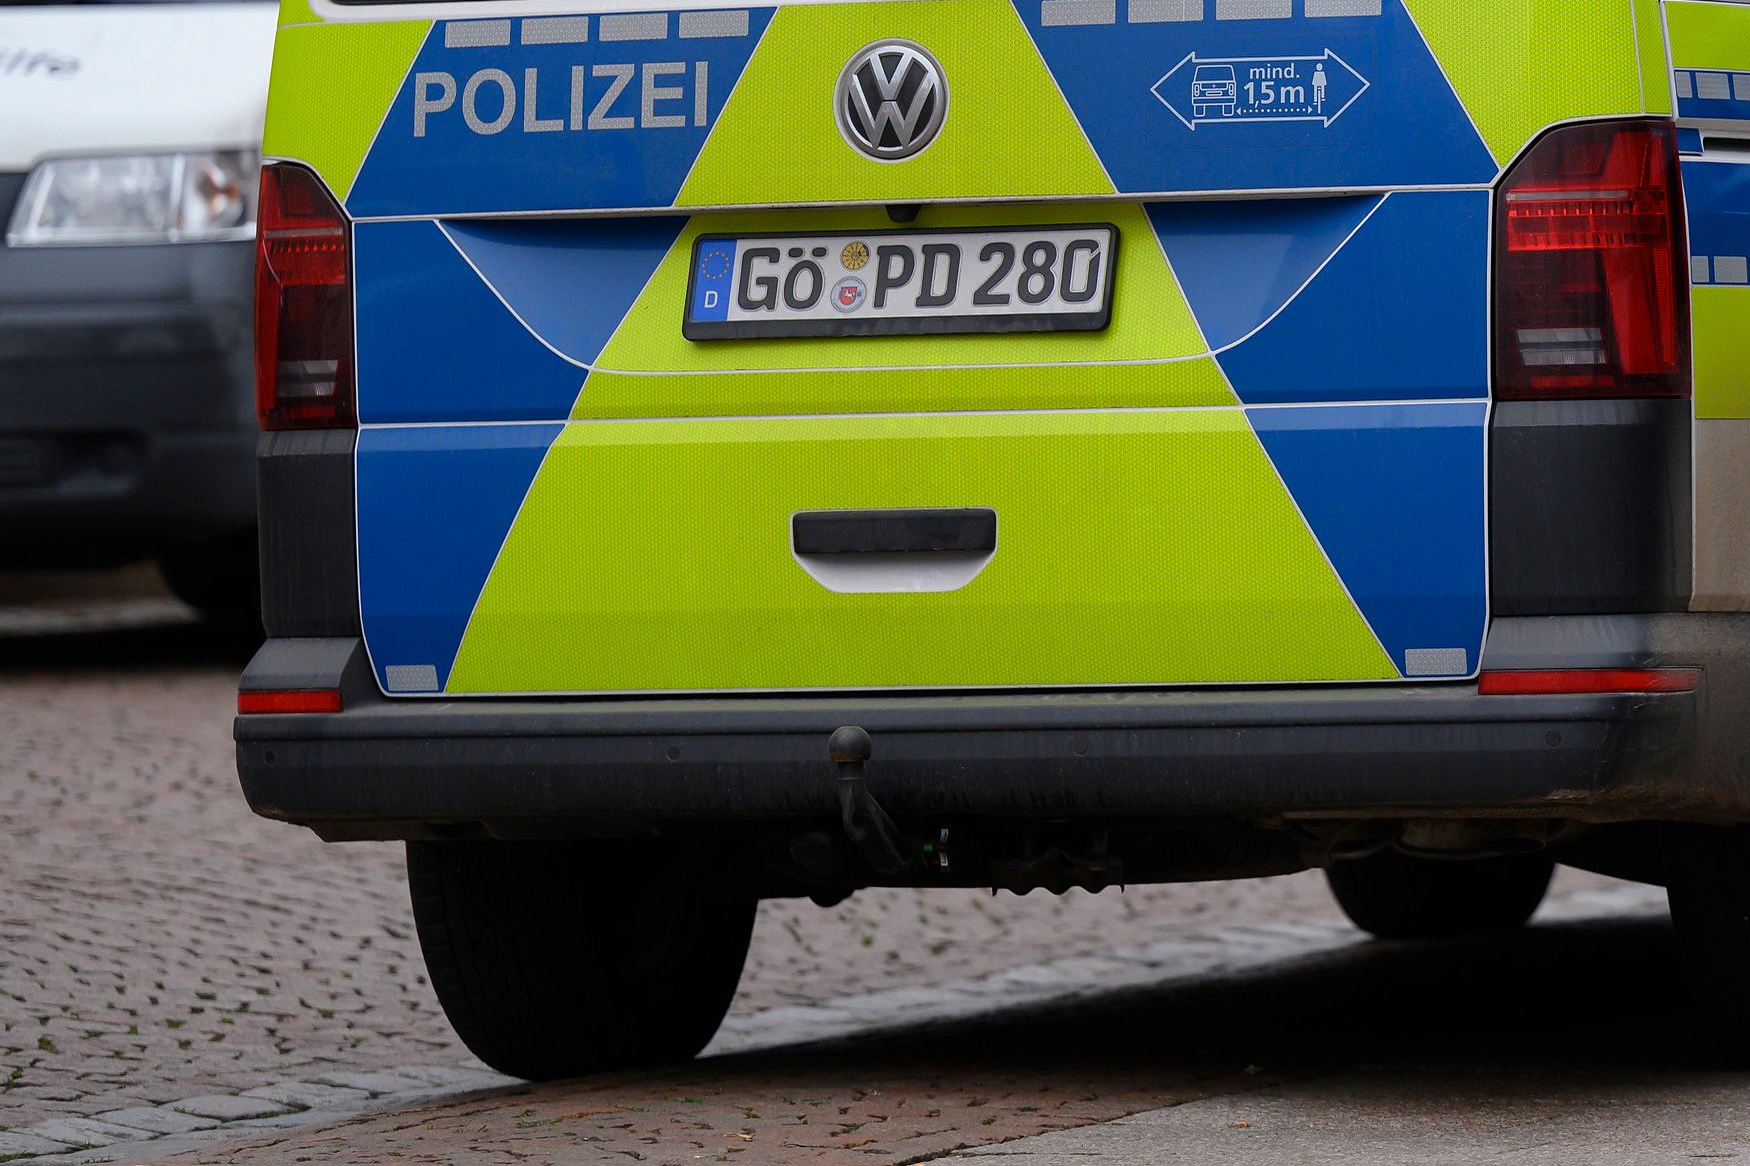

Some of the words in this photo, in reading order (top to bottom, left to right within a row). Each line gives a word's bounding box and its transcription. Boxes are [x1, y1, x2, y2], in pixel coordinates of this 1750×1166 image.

[413, 60, 709, 138] POLIZEI
[842, 46, 942, 153] VW
[1250, 63, 1300, 79] mind.
[704, 290, 718, 309] D
[737, 246, 828, 311] GÖ
[873, 242, 962, 308] PD
[972, 239, 1102, 306] 280
